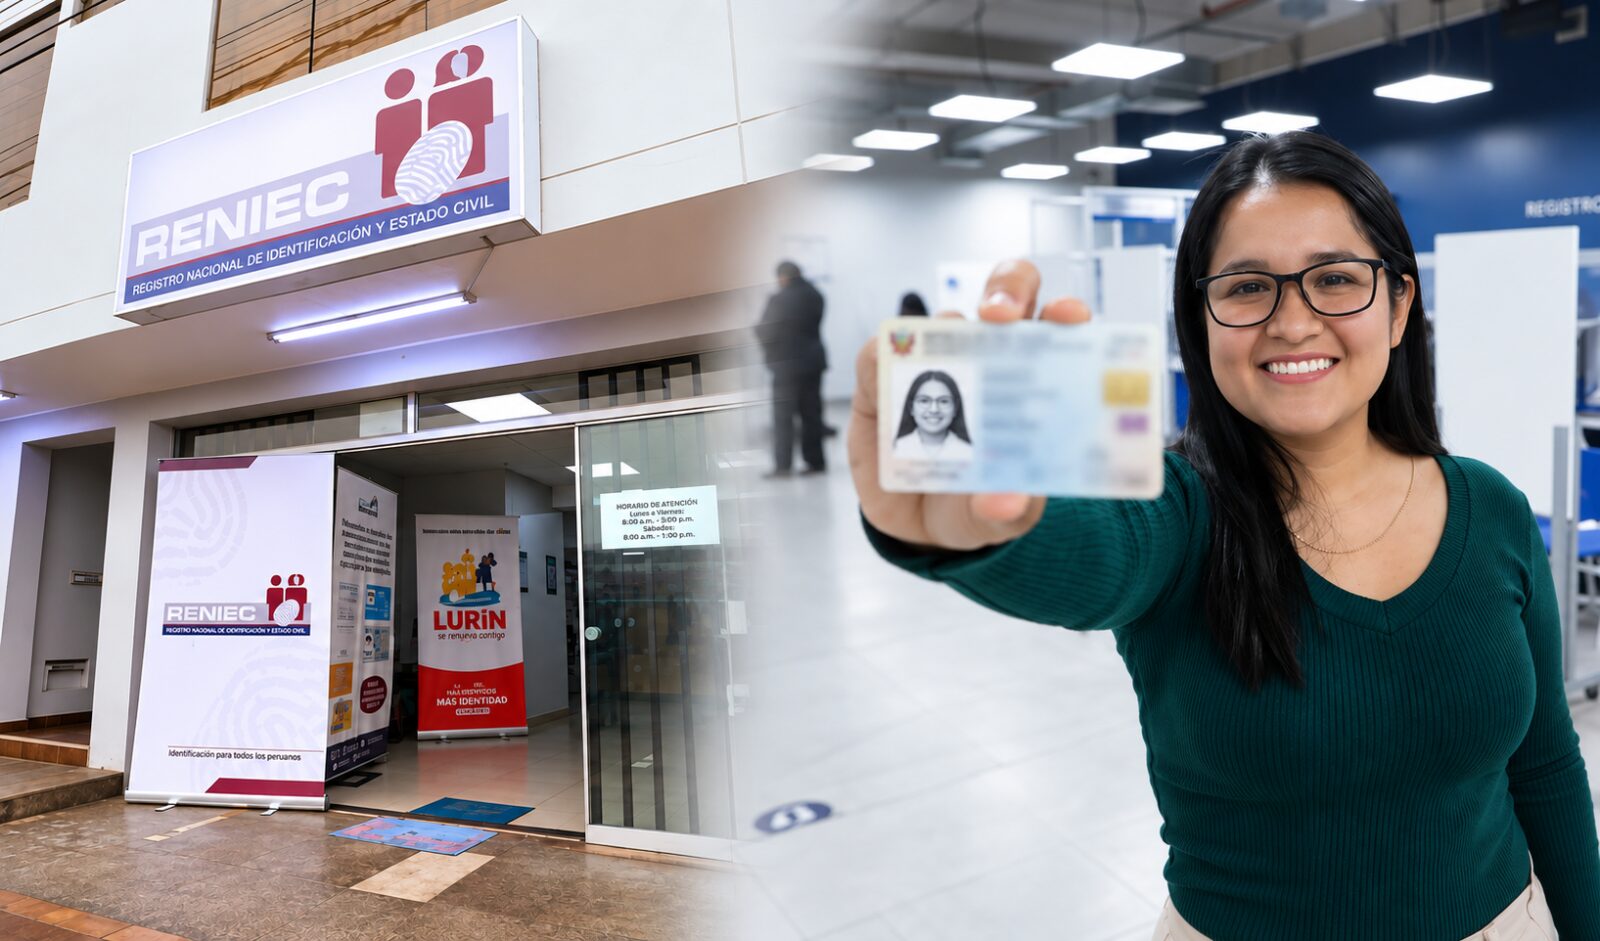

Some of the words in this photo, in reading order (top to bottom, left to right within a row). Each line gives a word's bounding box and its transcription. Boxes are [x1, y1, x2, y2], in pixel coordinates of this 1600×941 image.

[1525, 195, 1600, 218] REGISTRO
[135, 171, 349, 267] RENIEC
[132, 274, 184, 296] REGISTRO
[186, 260, 244, 282] NACIONAL
[247, 252, 263, 267] DE
[266, 225, 371, 262] IDENTIFICACIÓN
[375, 221, 386, 234] Y
[389, 205, 449, 231] ESTADO
[453, 195, 494, 215] CIVIL
[661, 498, 698, 507] ATENCIÓN
[167, 605, 256, 621] RENIEC
[448, 632, 477, 641] renueva
[479, 631, 506, 641] contigo
[459, 695, 508, 706] IDENTIDAD
[168, 749, 215, 758] Identificación
[233, 752, 254, 760] todos
[255, 752, 266, 760] los
[267, 753, 302, 761] peruanos
